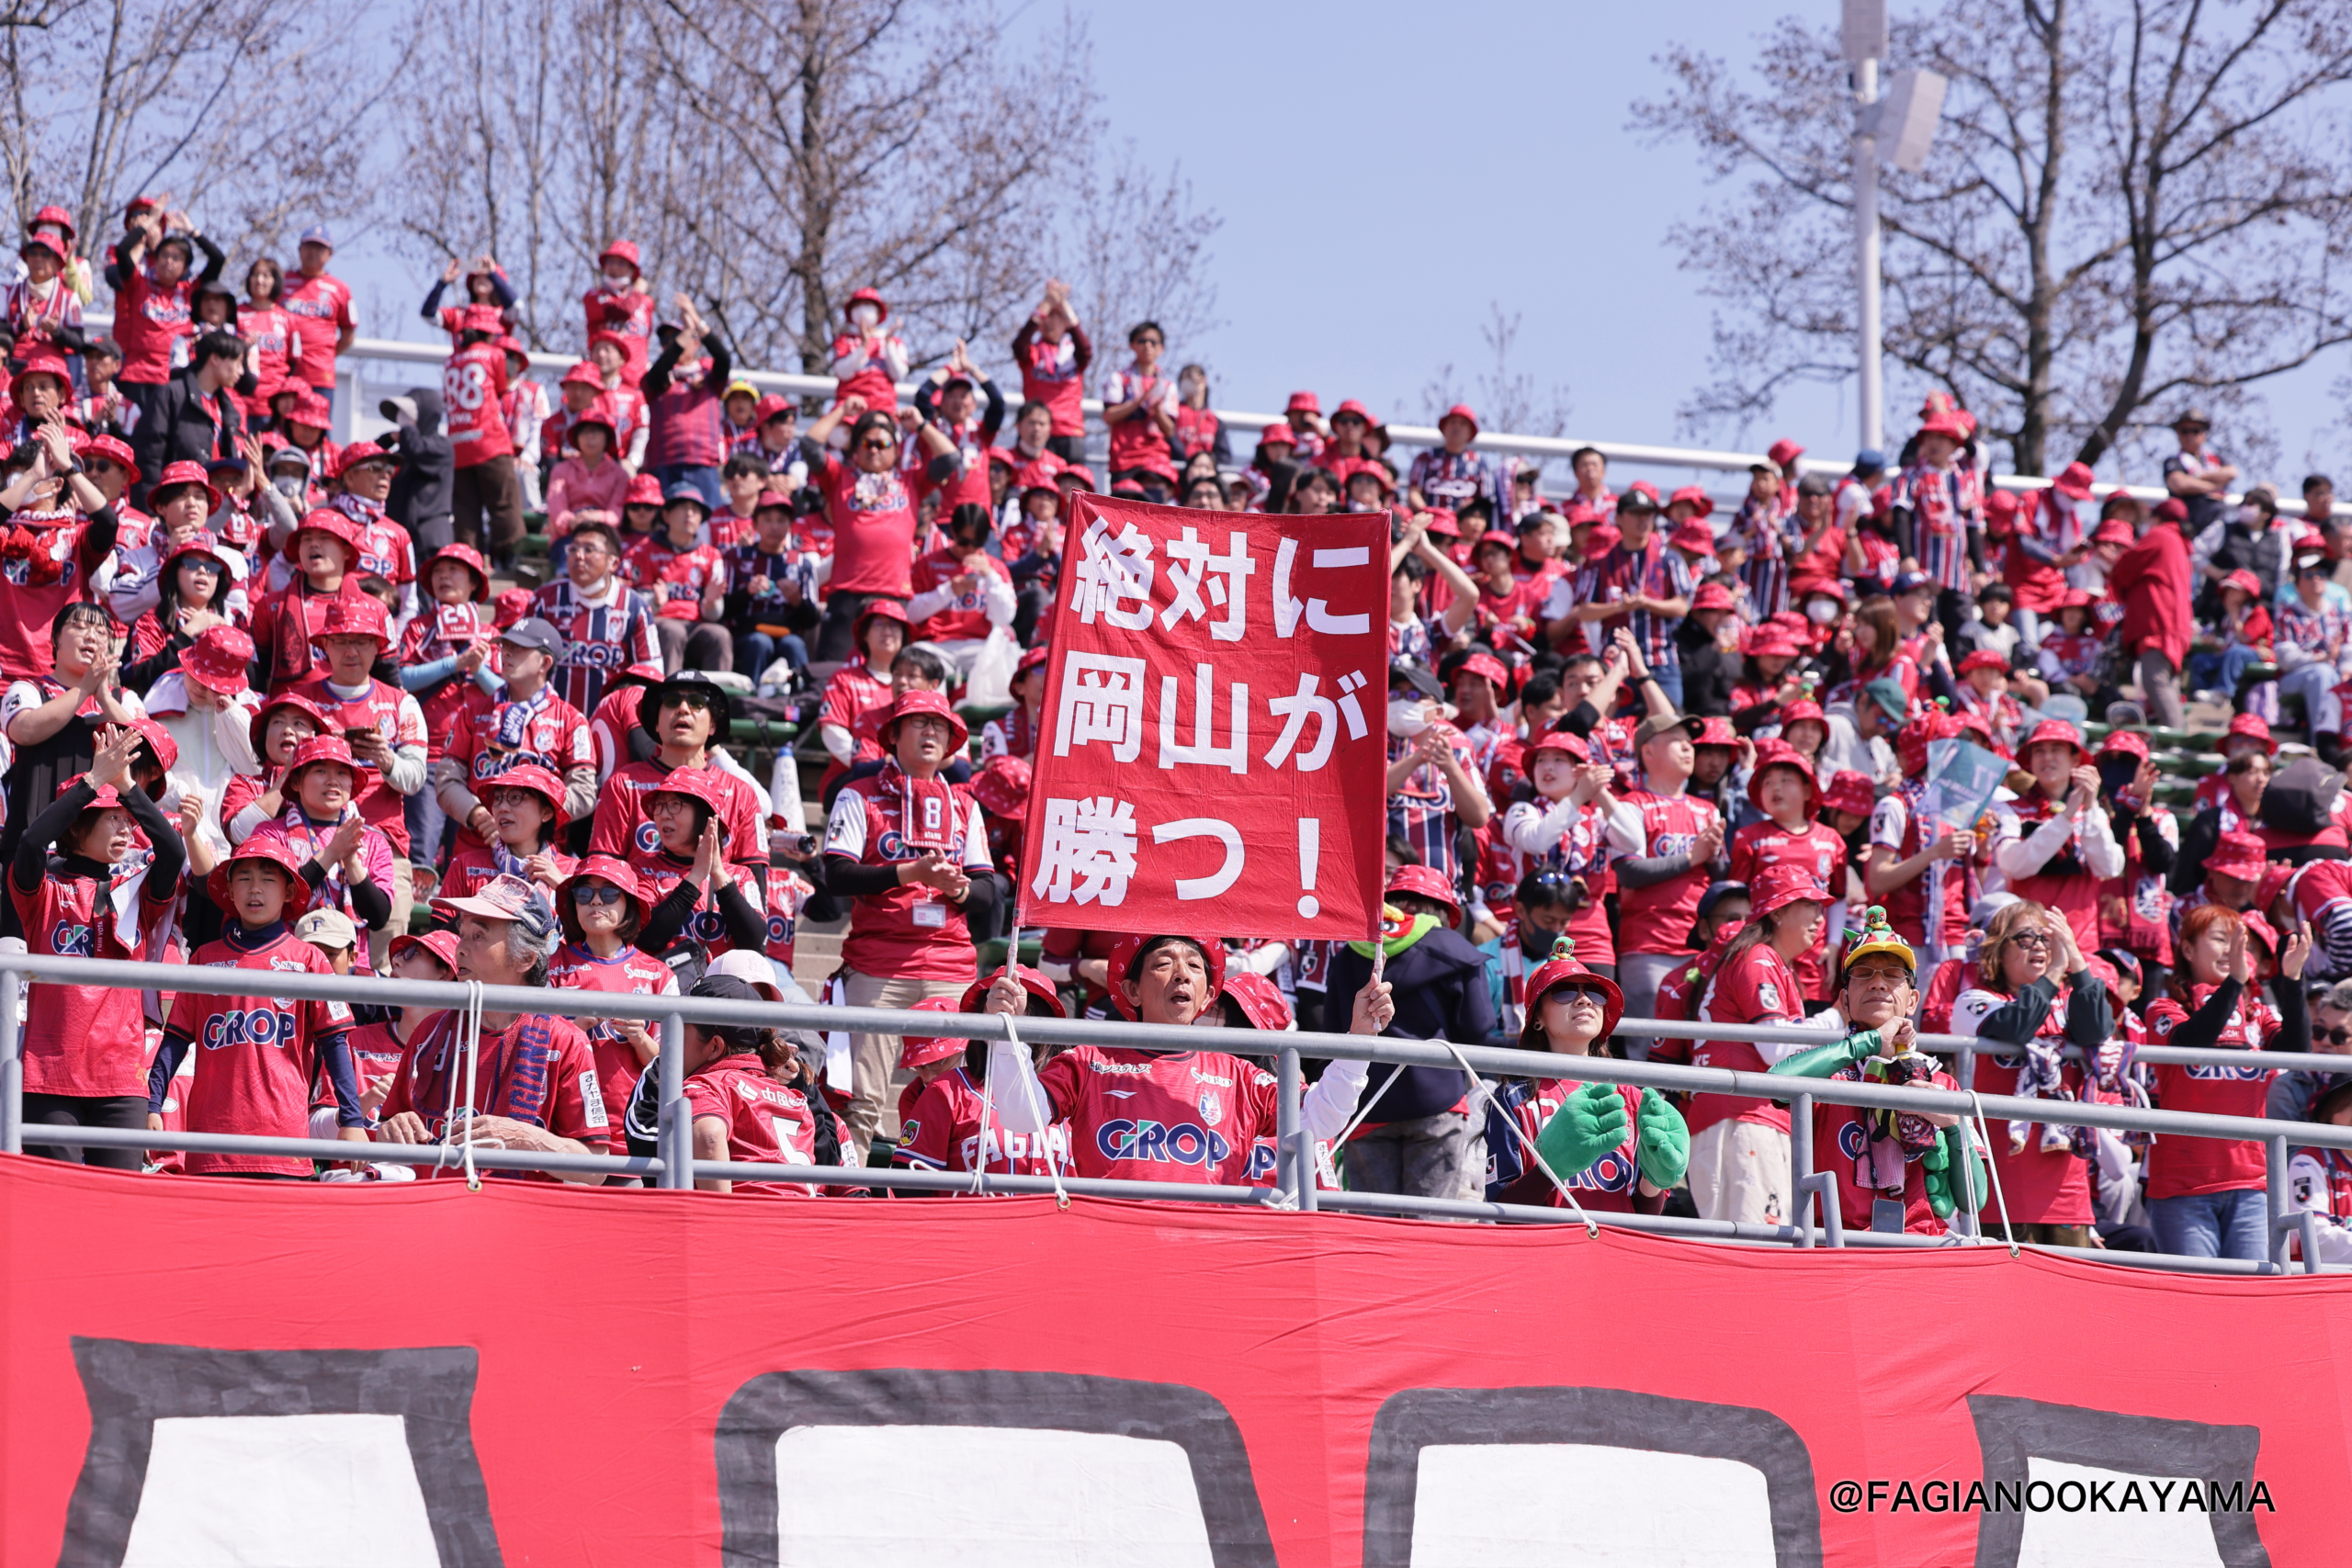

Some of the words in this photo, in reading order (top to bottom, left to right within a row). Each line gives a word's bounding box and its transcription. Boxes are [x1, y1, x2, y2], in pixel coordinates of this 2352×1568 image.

[1069, 514, 1371, 642] 絶対に
[1053, 649, 1369, 774] 岡山が
[924, 796, 942, 829] 8
[1031, 795, 1320, 919] 勝つ！
[203, 1008, 296, 1051] GROP
[961, 1126, 1076, 1172] FAGIA
[1097, 1118, 1230, 1172] GROP
